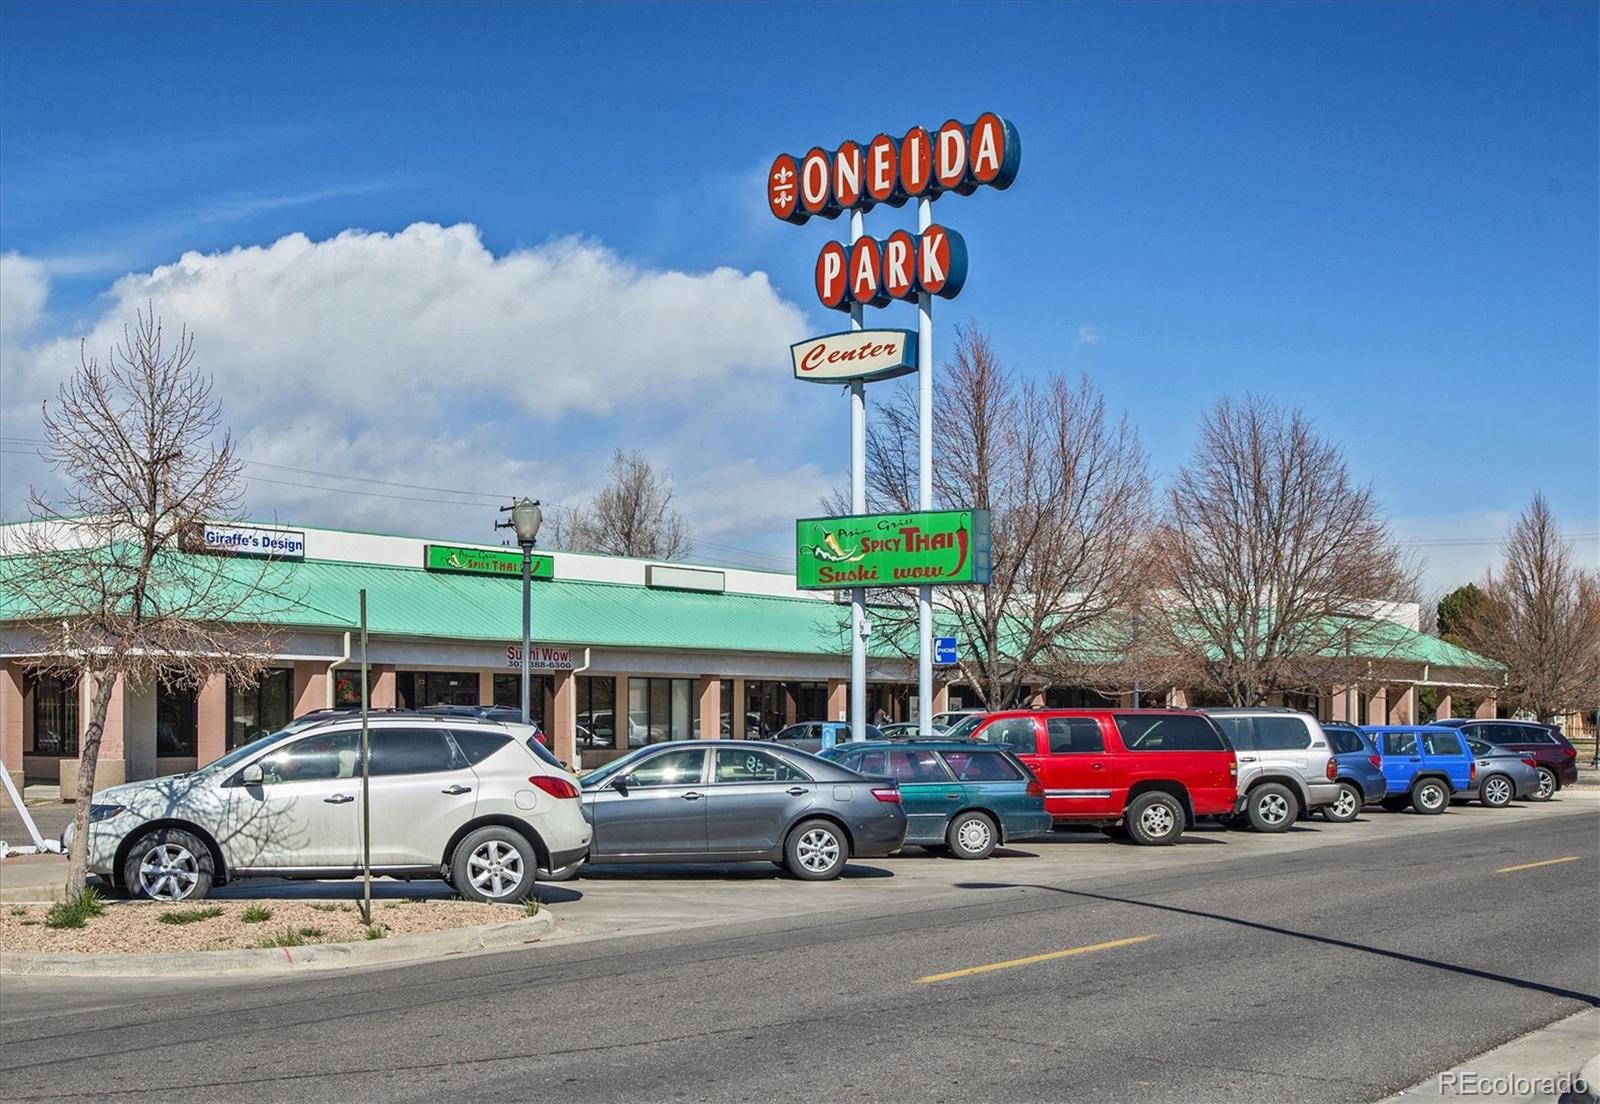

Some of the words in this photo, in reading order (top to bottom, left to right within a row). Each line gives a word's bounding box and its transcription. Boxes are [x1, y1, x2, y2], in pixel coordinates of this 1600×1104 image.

[803, 123, 999, 204] ONEIDA
[823, 233, 945, 298] PARK
[801, 341, 897, 371] Center
[206, 531, 259, 547] Giraffe's
[262, 536, 303, 553] Design
[861, 537, 900, 554] SPICY
[900, 527, 954, 553] THAI
[819, 565, 879, 584] Sushi
[893, 565, 944, 579] wow
[507, 646, 539, 661] Suhi
[542, 647, 571, 662] Wow!
